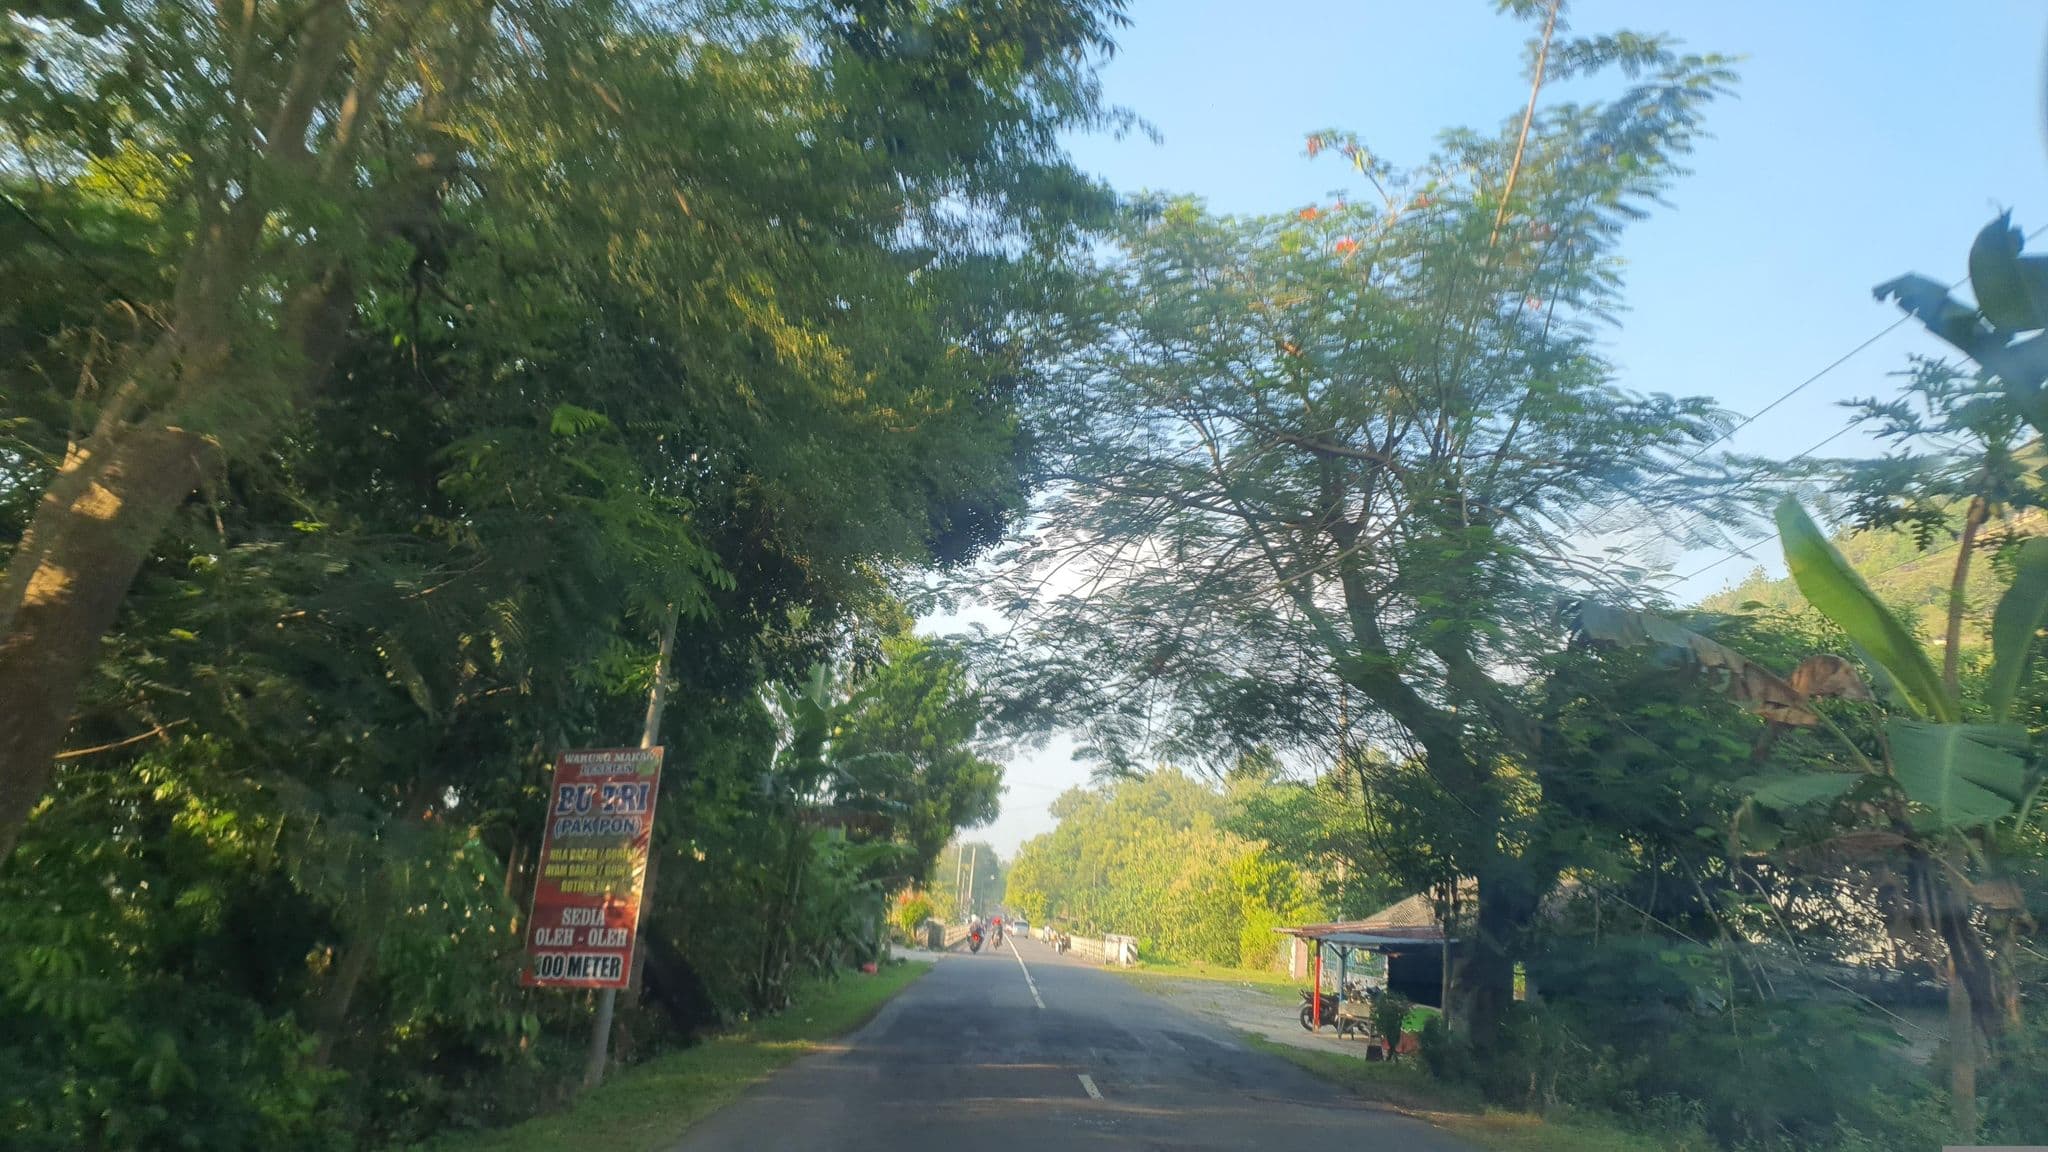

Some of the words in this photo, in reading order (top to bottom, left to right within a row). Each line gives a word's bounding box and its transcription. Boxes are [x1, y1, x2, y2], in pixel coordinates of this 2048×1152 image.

[556, 784, 597, 815] BU
[562, 908, 606, 926] SEDIA
[535, 929, 574, 946] OLEH
[587, 929, 628, 946] OLEH
[566, 954, 623, 979] METER
